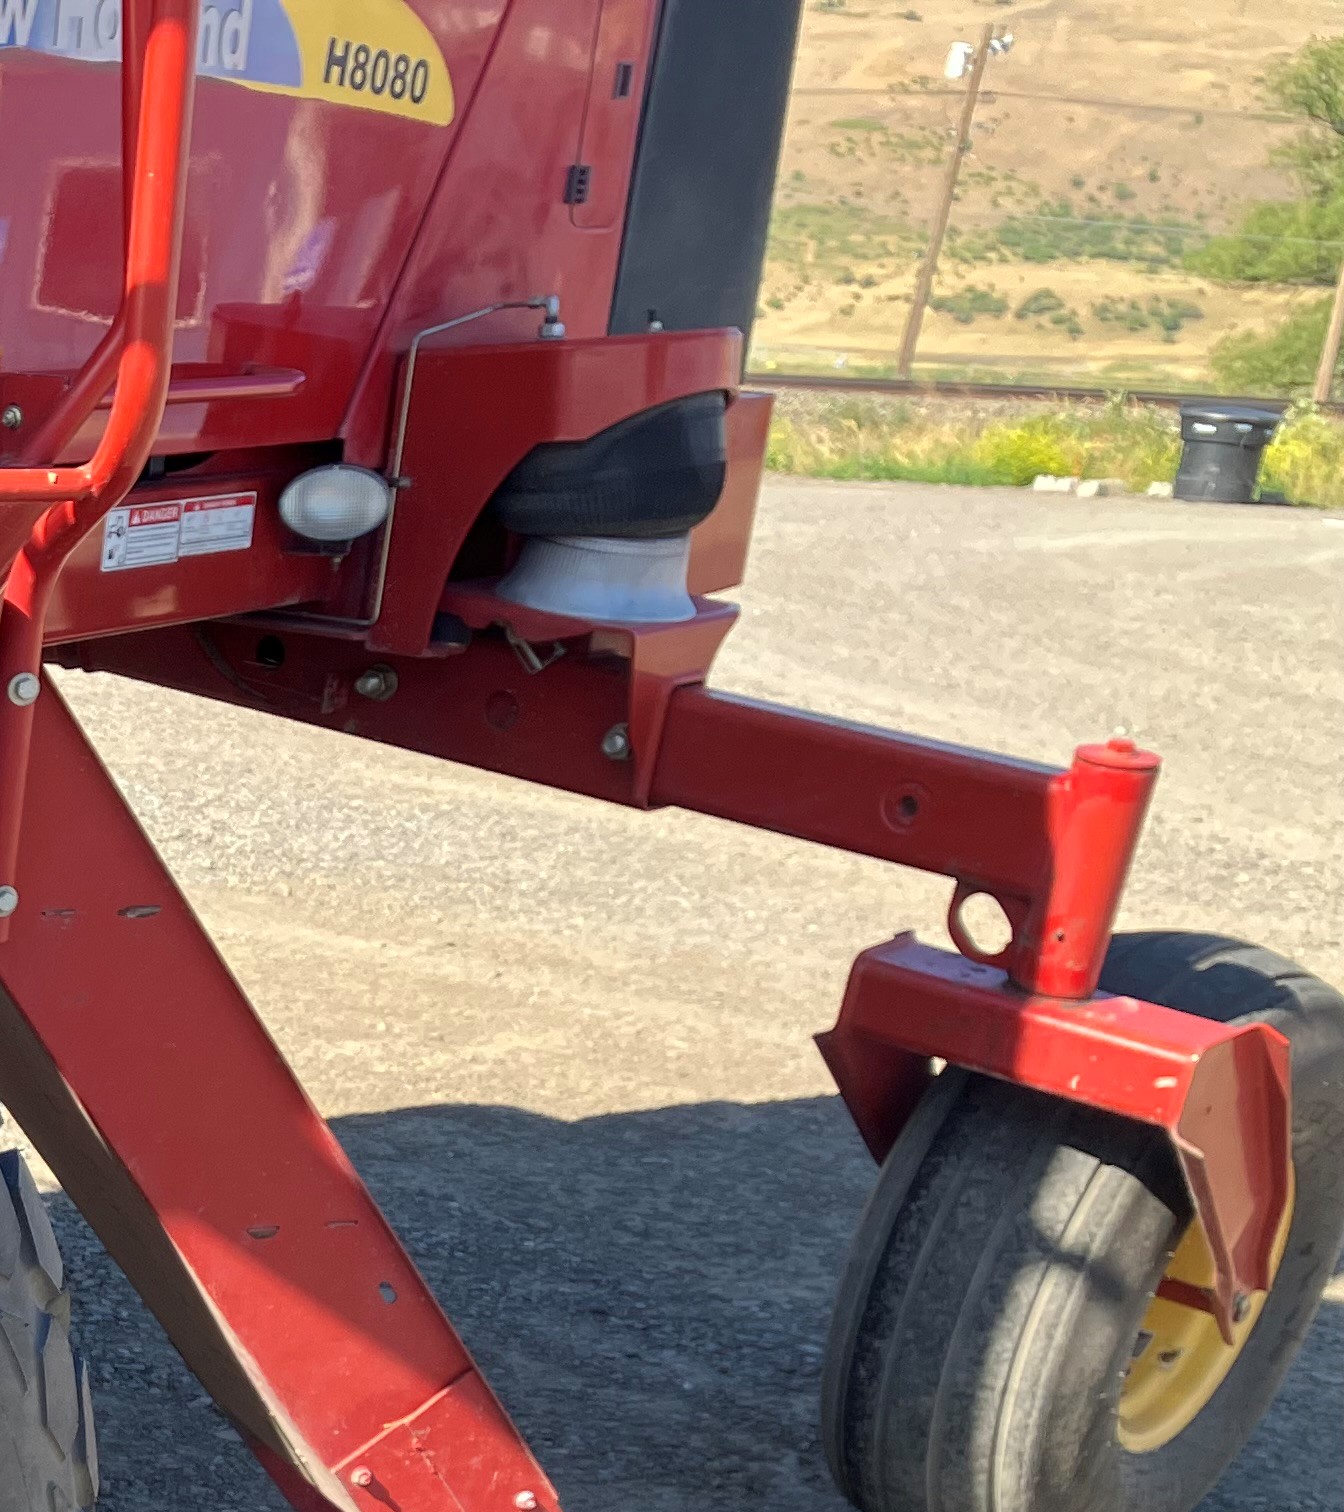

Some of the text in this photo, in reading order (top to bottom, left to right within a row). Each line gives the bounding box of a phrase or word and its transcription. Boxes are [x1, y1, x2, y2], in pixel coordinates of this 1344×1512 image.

[53, 0, 252, 71] Hond
[323, 37, 429, 104] H8080
[142, 507, 178, 522] DANGER
